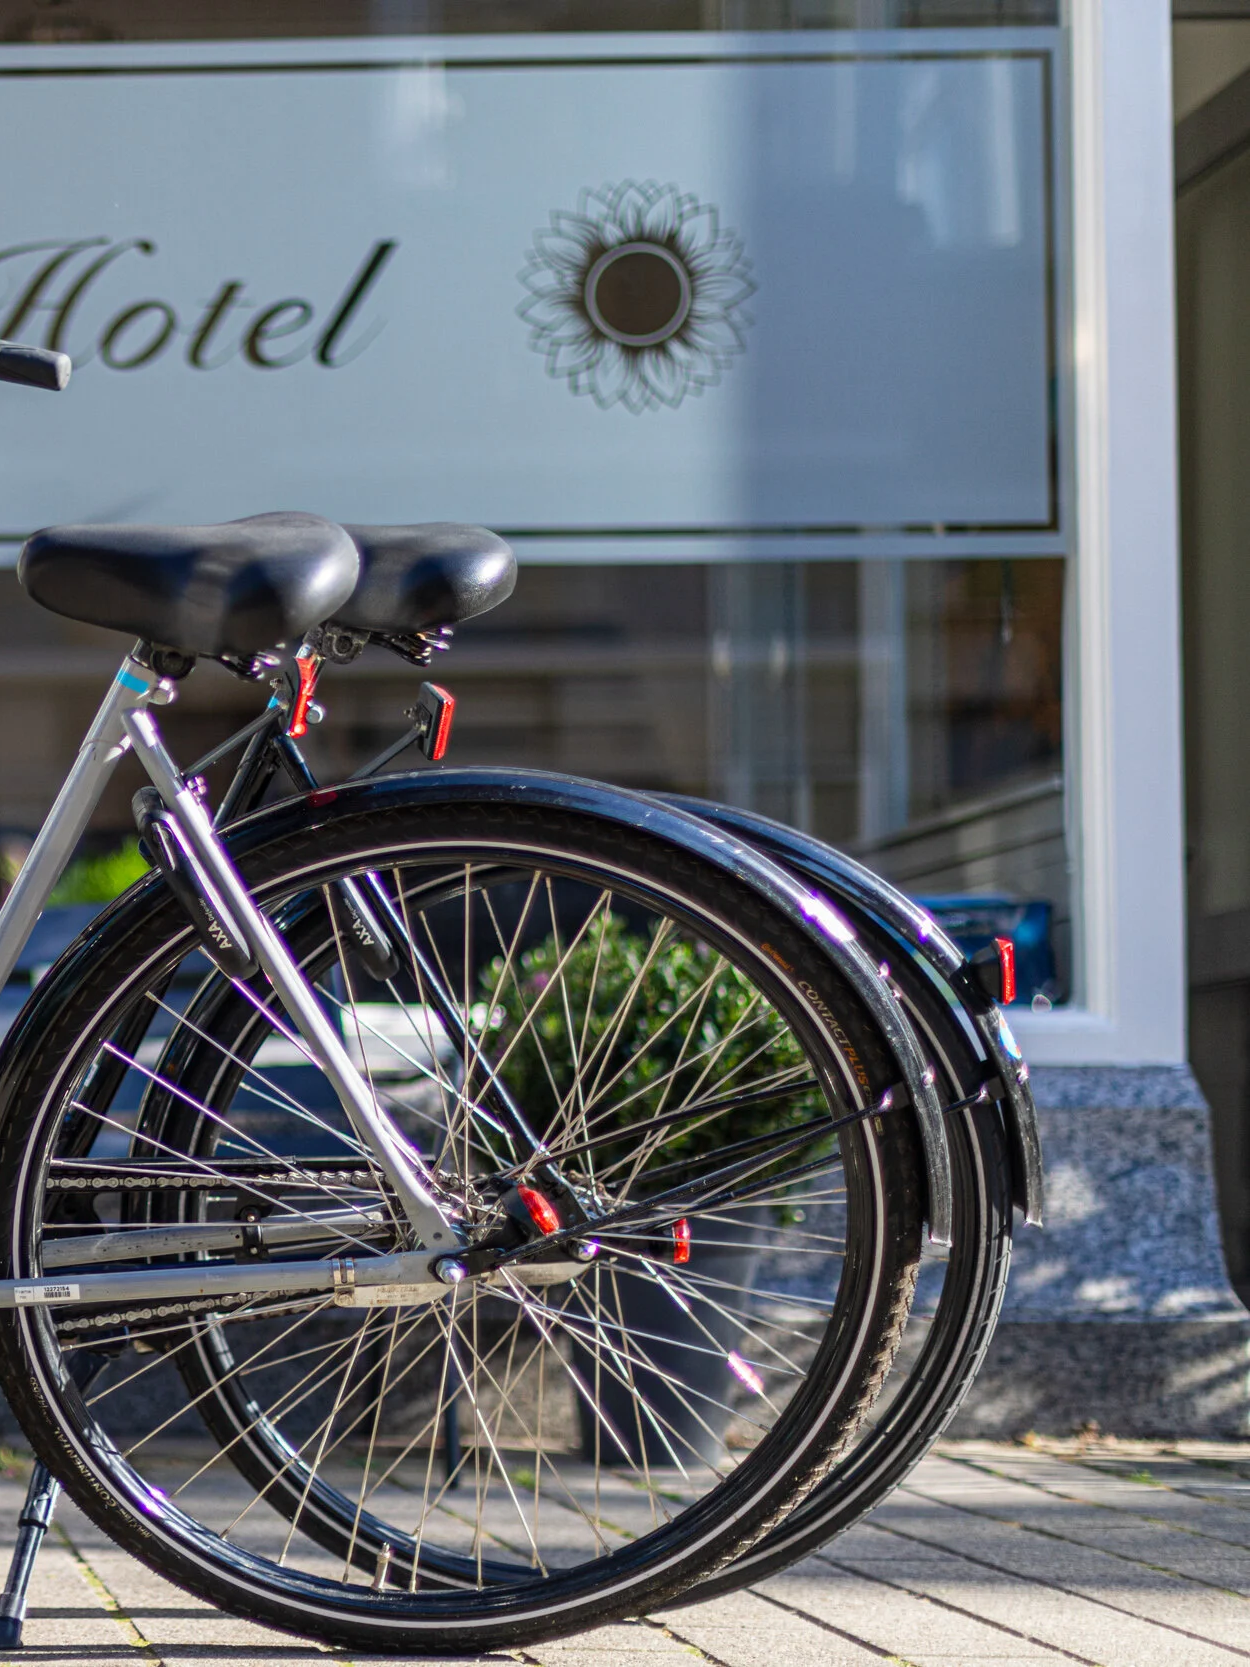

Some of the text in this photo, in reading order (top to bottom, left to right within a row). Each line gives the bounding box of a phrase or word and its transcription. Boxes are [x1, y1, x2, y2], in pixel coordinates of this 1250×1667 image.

[208, 920, 233, 949] AXA
[352, 918, 375, 946] AXA
[797, 980, 869, 1085] CONTACT PLUS
[54, 1426, 118, 1508] CONTINENTAL
